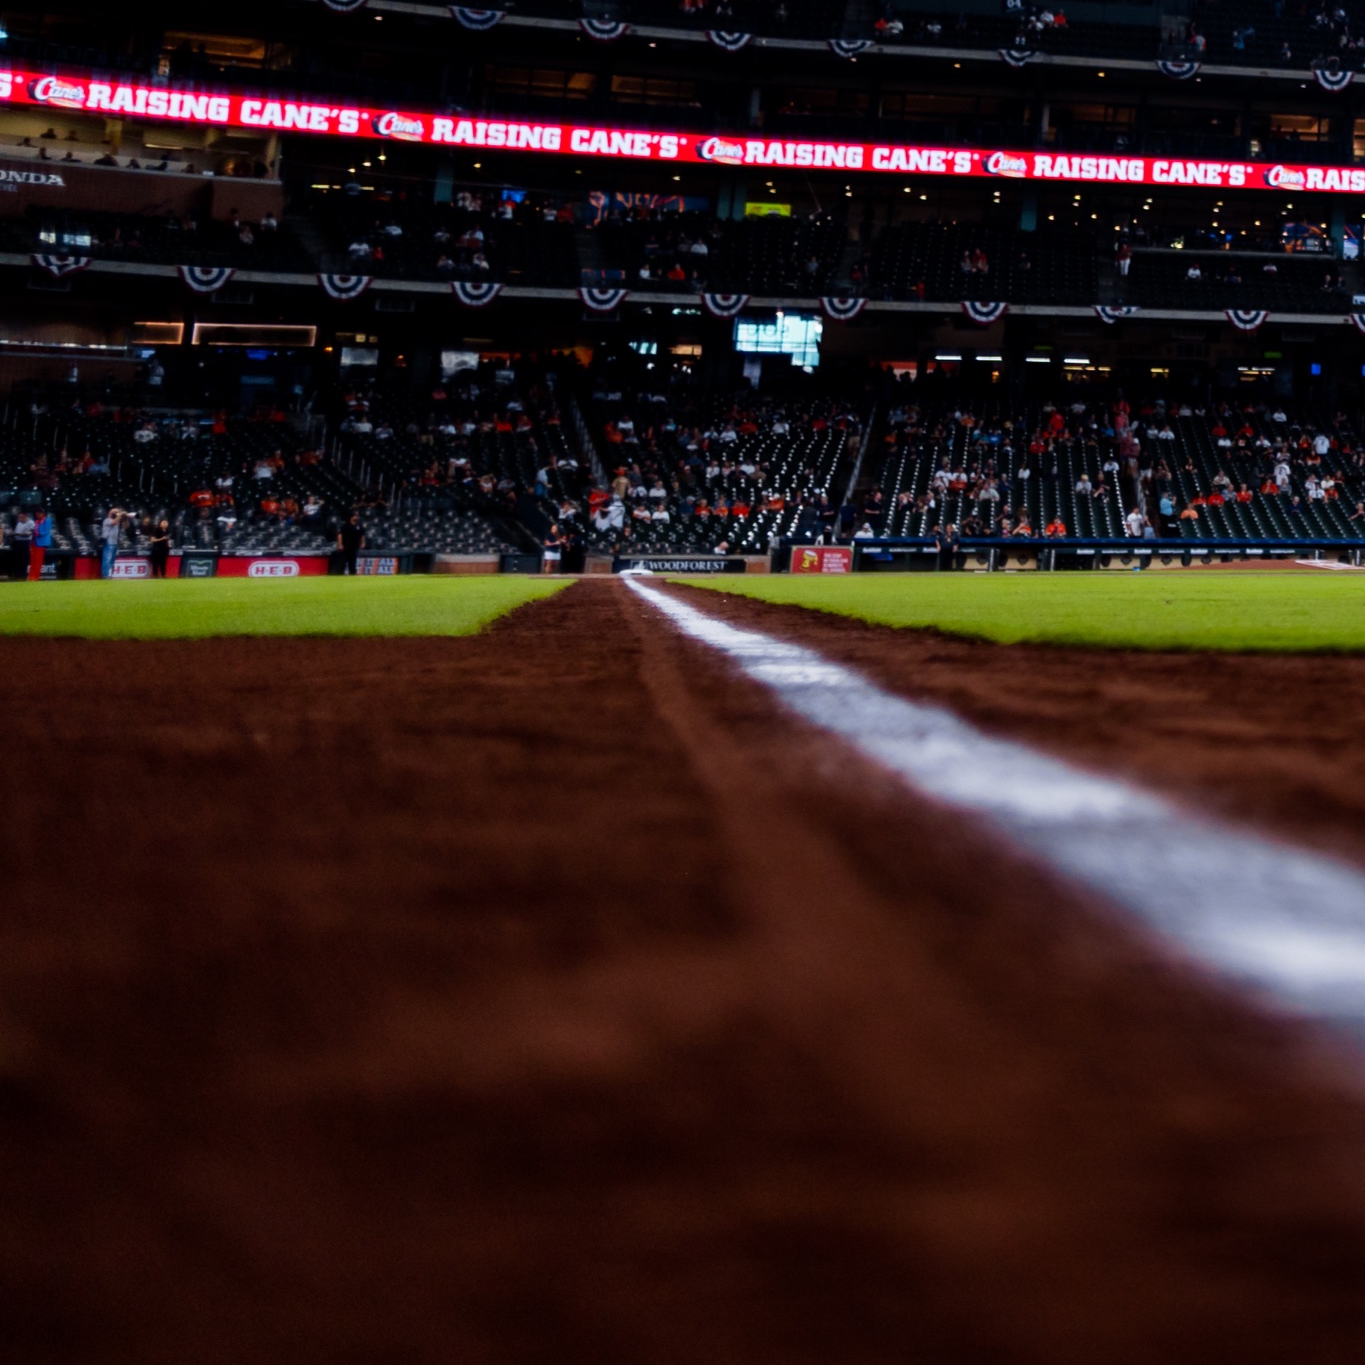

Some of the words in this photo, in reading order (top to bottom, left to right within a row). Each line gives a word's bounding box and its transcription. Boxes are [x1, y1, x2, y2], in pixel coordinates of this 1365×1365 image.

[34, 77, 86, 108] Cane's
[86, 83, 230, 122] RAISING
[240, 100, 359, 134] CANE'S
[379, 112, 424, 141] Cane's
[431, 118, 562, 150] RAISING
[570, 128, 680, 158] CANE'S
[702, 137, 744, 165] Cane's
[744, 141, 864, 170] RAISING
[872, 147, 973, 174] CANE'S
[988, 151, 1027, 174] Cane's
[1033, 155, 1145, 183] RAISING
[1152, 161, 1246, 187] CANE'S
[1269, 165, 1305, 189] Cane's
[648, 561, 728, 571] WOODFOREST
